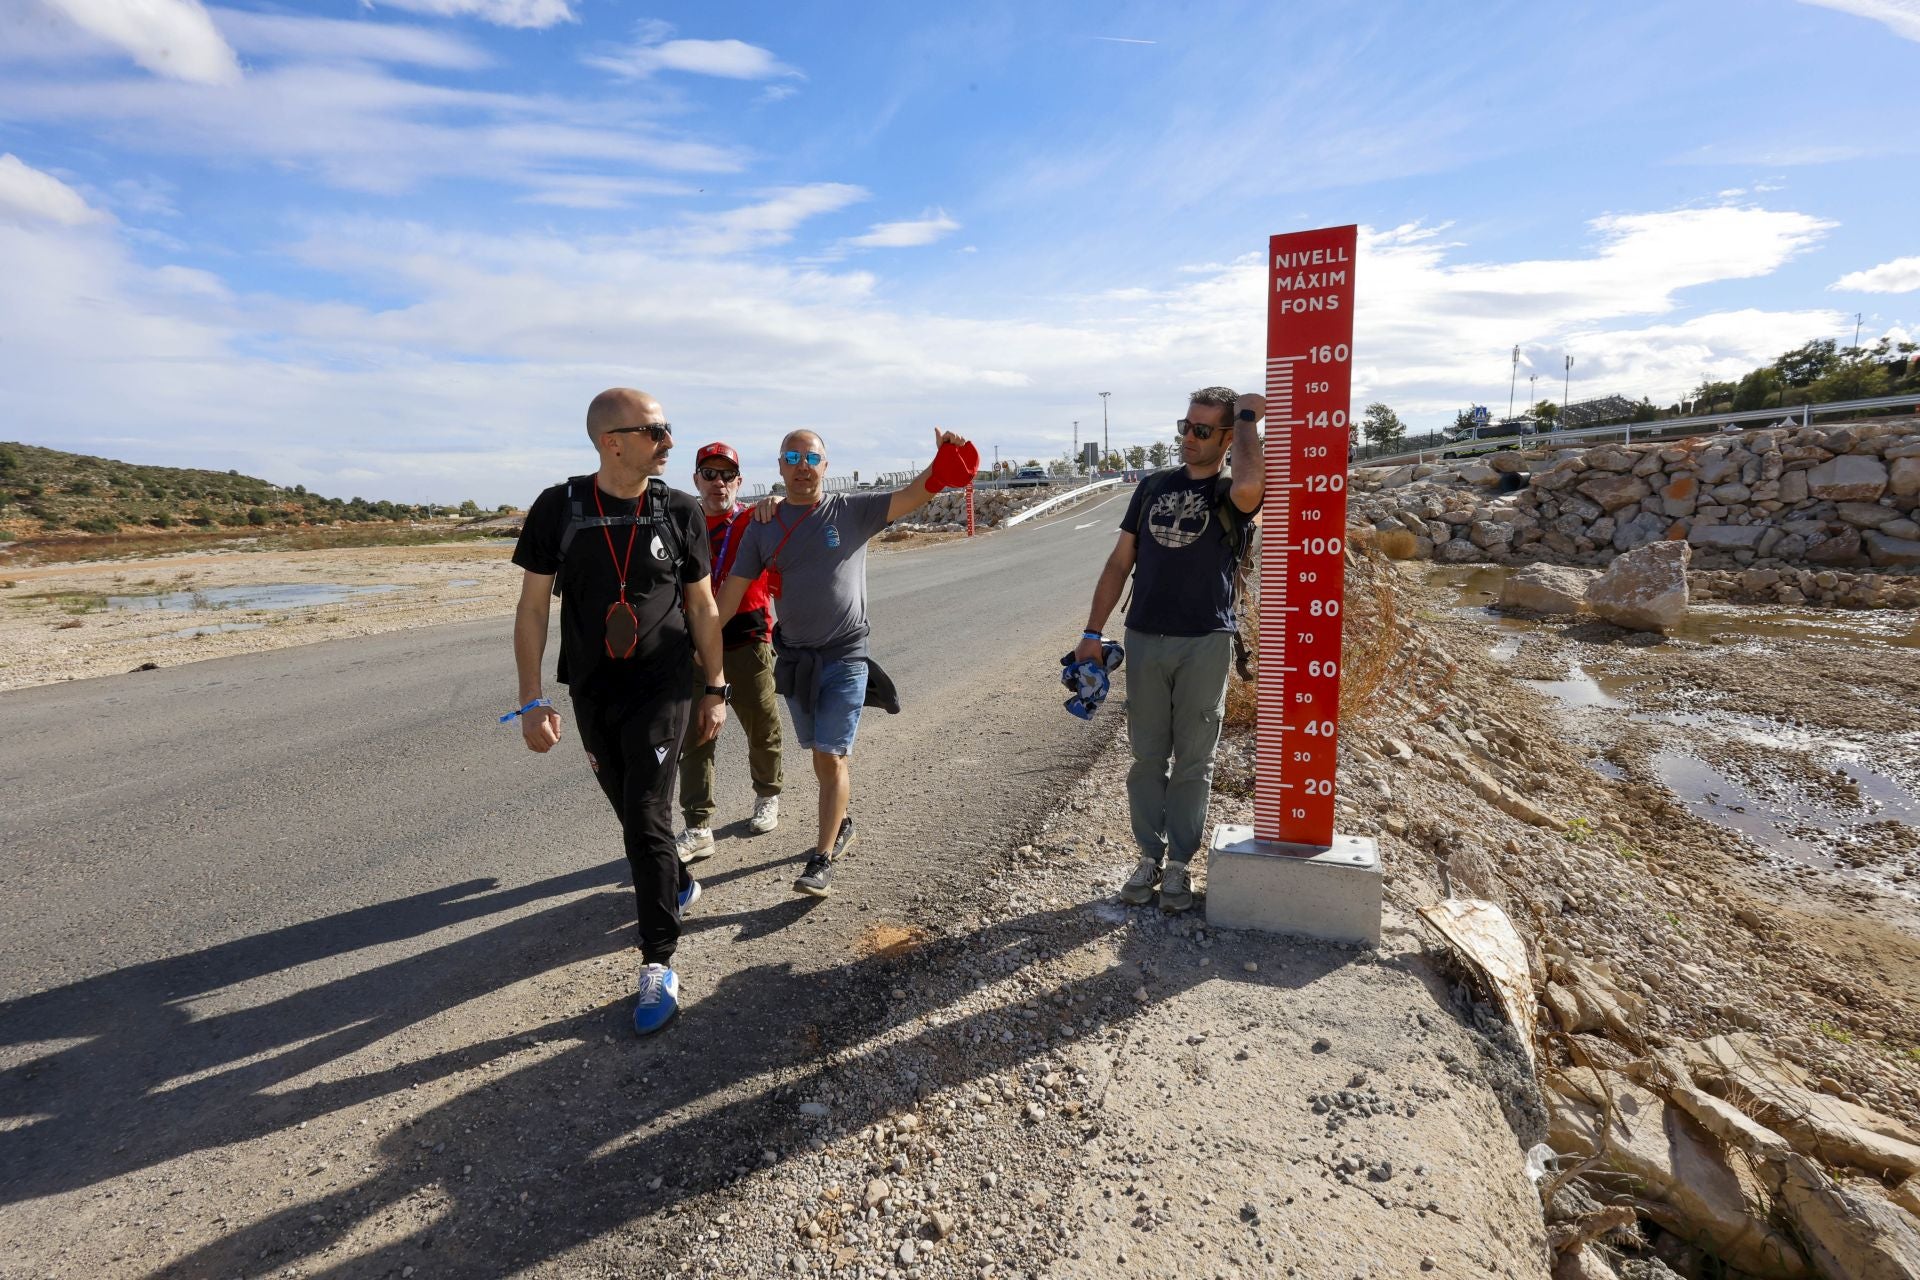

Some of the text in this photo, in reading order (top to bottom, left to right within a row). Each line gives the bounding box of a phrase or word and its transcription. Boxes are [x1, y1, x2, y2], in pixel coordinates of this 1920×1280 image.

[1275, 247, 1349, 269] NIVELL
[1276, 270, 1345, 292] MÁXIM
[1281, 294, 1339, 314] FONS
[1309, 343, 1349, 364] 160
[1305, 381, 1329, 393] 150
[1306, 409, 1346, 429] 140
[1303, 446, 1327, 458] 130
[1305, 474, 1344, 492] 120
[1301, 510, 1321, 521] 110
[1302, 537, 1342, 555] 100
[1299, 572, 1317, 583] 90
[1309, 599, 1339, 617] 80
[1297, 633, 1314, 644] 70
[1308, 660, 1337, 678] 60
[1295, 693, 1312, 704] 50
[1303, 720, 1335, 738] 40
[1293, 751, 1311, 763] 30
[1304, 778, 1332, 796] 20
[1291, 808, 1306, 819] 10
